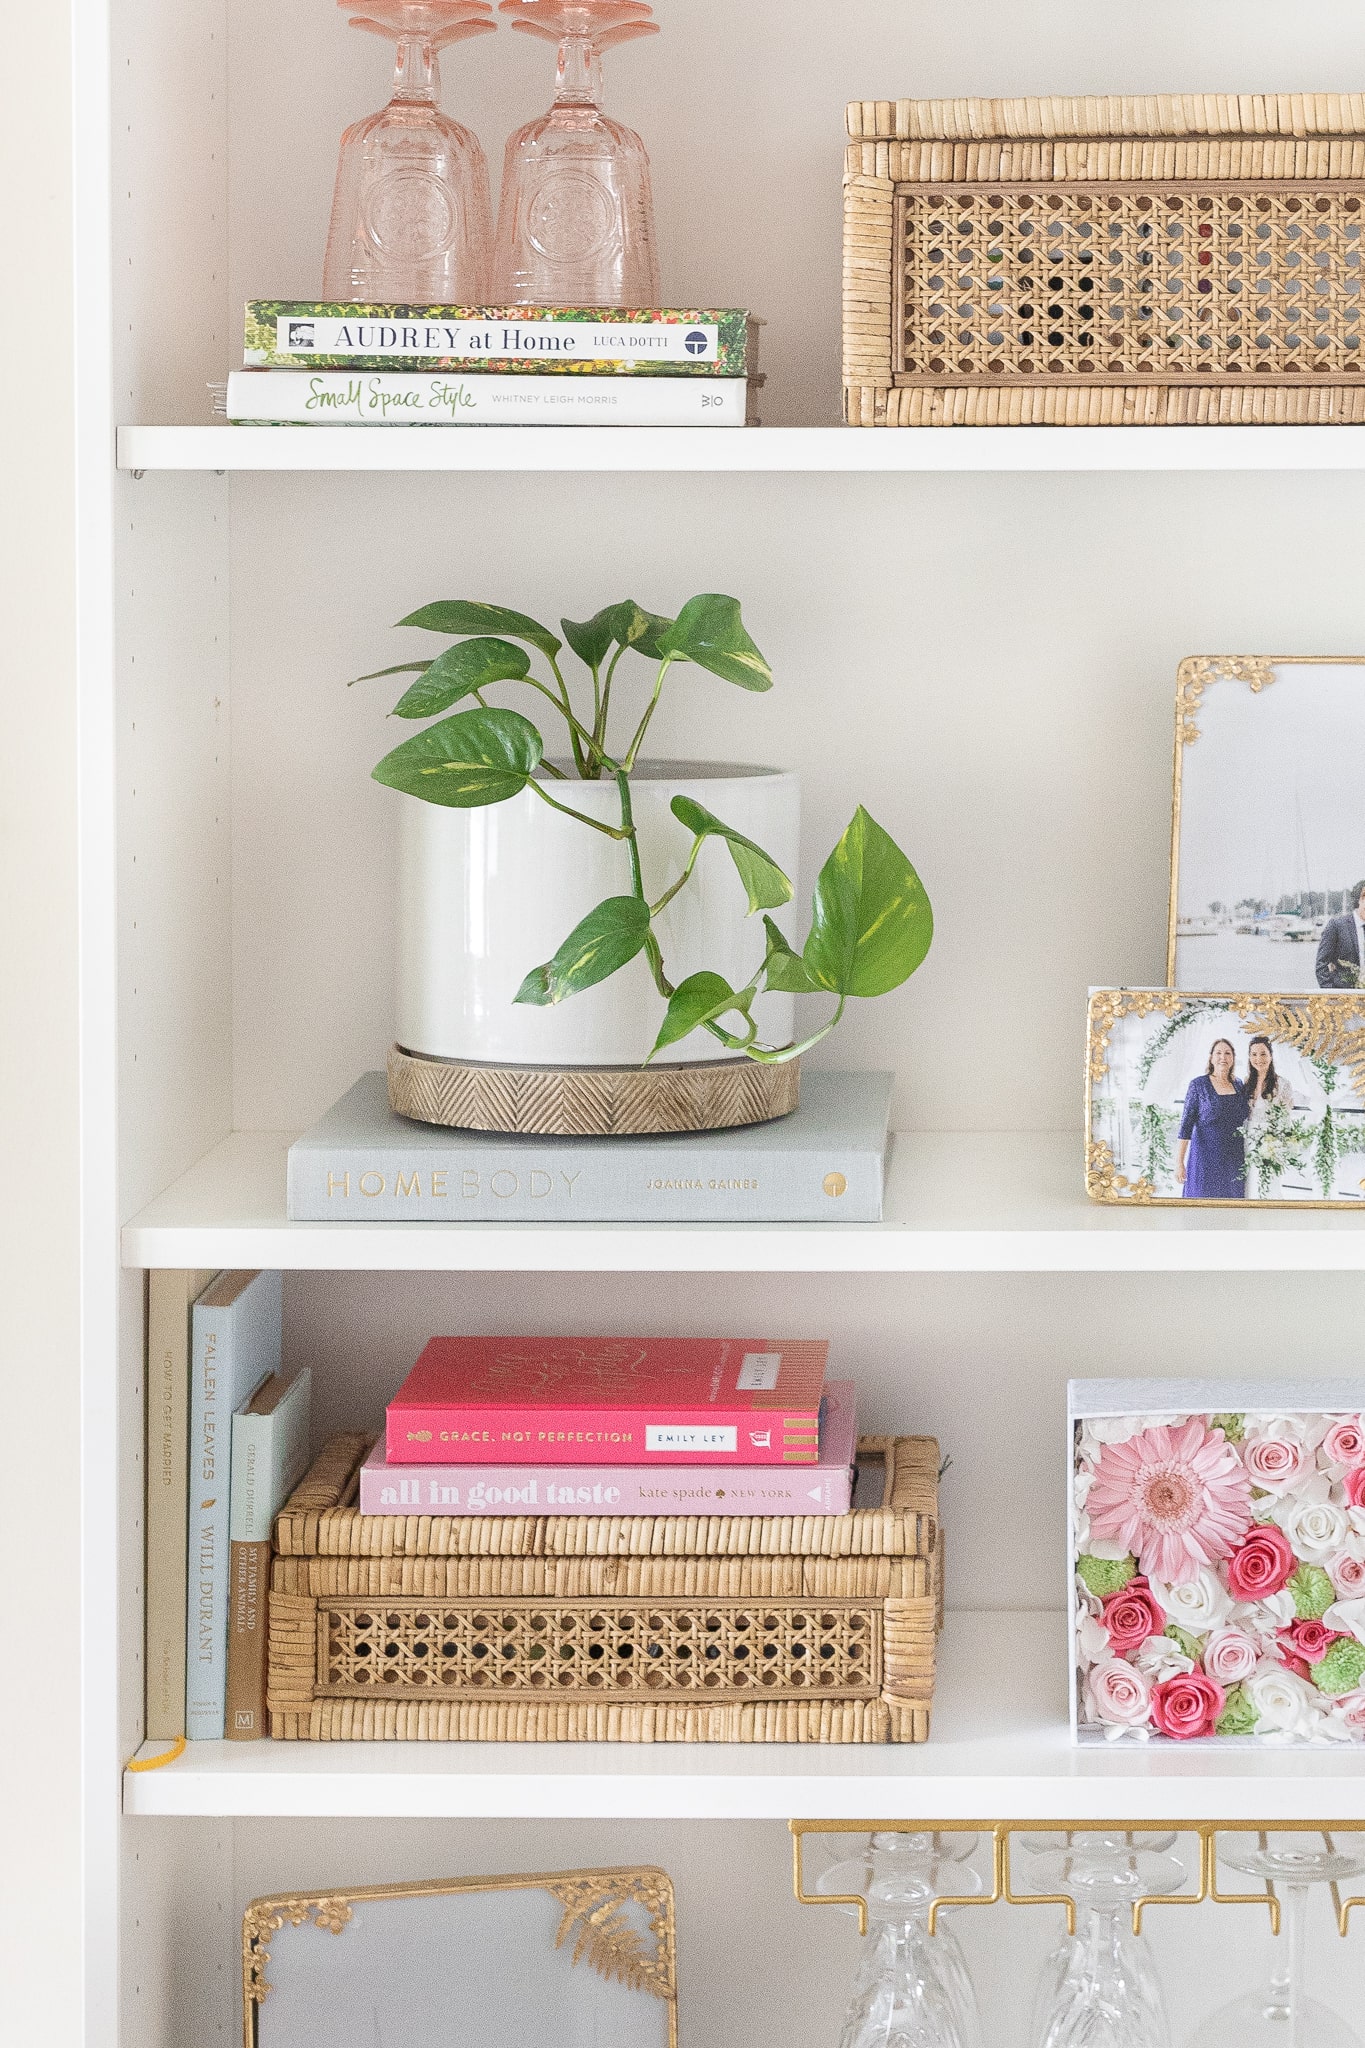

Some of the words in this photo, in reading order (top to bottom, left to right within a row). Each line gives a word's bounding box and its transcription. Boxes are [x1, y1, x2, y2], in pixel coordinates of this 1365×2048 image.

[334, 325, 460, 349] AUDREY
[469, 334, 492, 350] at
[502, 329, 576, 351] Home
[593, 335, 625, 347] LUCA
[629, 336, 668, 348] DOTTI
[305, 377, 365, 418] Small
[368, 377, 424, 417] Space
[428, 380, 477, 418] Style
[491, 394, 540, 404] WHITNEY
[543, 395, 574, 405] LEIGH
[577, 395, 618, 405] MORRIS
[326, 1169, 582, 1198] HOMEBODY
[646, 1178, 704, 1190] JOANNA
[708, 1178, 760, 1190] GAINES
[204, 1333, 216, 1401] FALLEN
[202, 1411, 215, 1481] LEAVES
[501, 1431, 532, 1443] NOT
[537, 1431, 633, 1443] PERFECTION
[657, 1434, 696, 1443] EMILY
[703, 1434, 726, 1443] LEY
[161, 1432, 171, 1486] MARRIED
[245, 1443, 256, 1486] GERALD
[379, 1479, 422, 1505] all
[428, 1479, 461, 1505] in
[466, 1479, 538, 1511] good
[546, 1481, 621, 1505] taste
[638, 1486, 668, 1498] kate
[672, 1486, 712, 1502] spade
[730, 1490, 756, 1498] NEW
[761, 1490, 793, 1499] YORK
[199, 1526, 214, 1575] WILL
[238, 1547, 247, 1586] OTHER
[248, 1547, 258, 1560] MY
[248, 1566, 257, 1606] FAMILY
[198, 1580, 213, 1665] DURANT
[247, 1608, 256, 1630] AND
